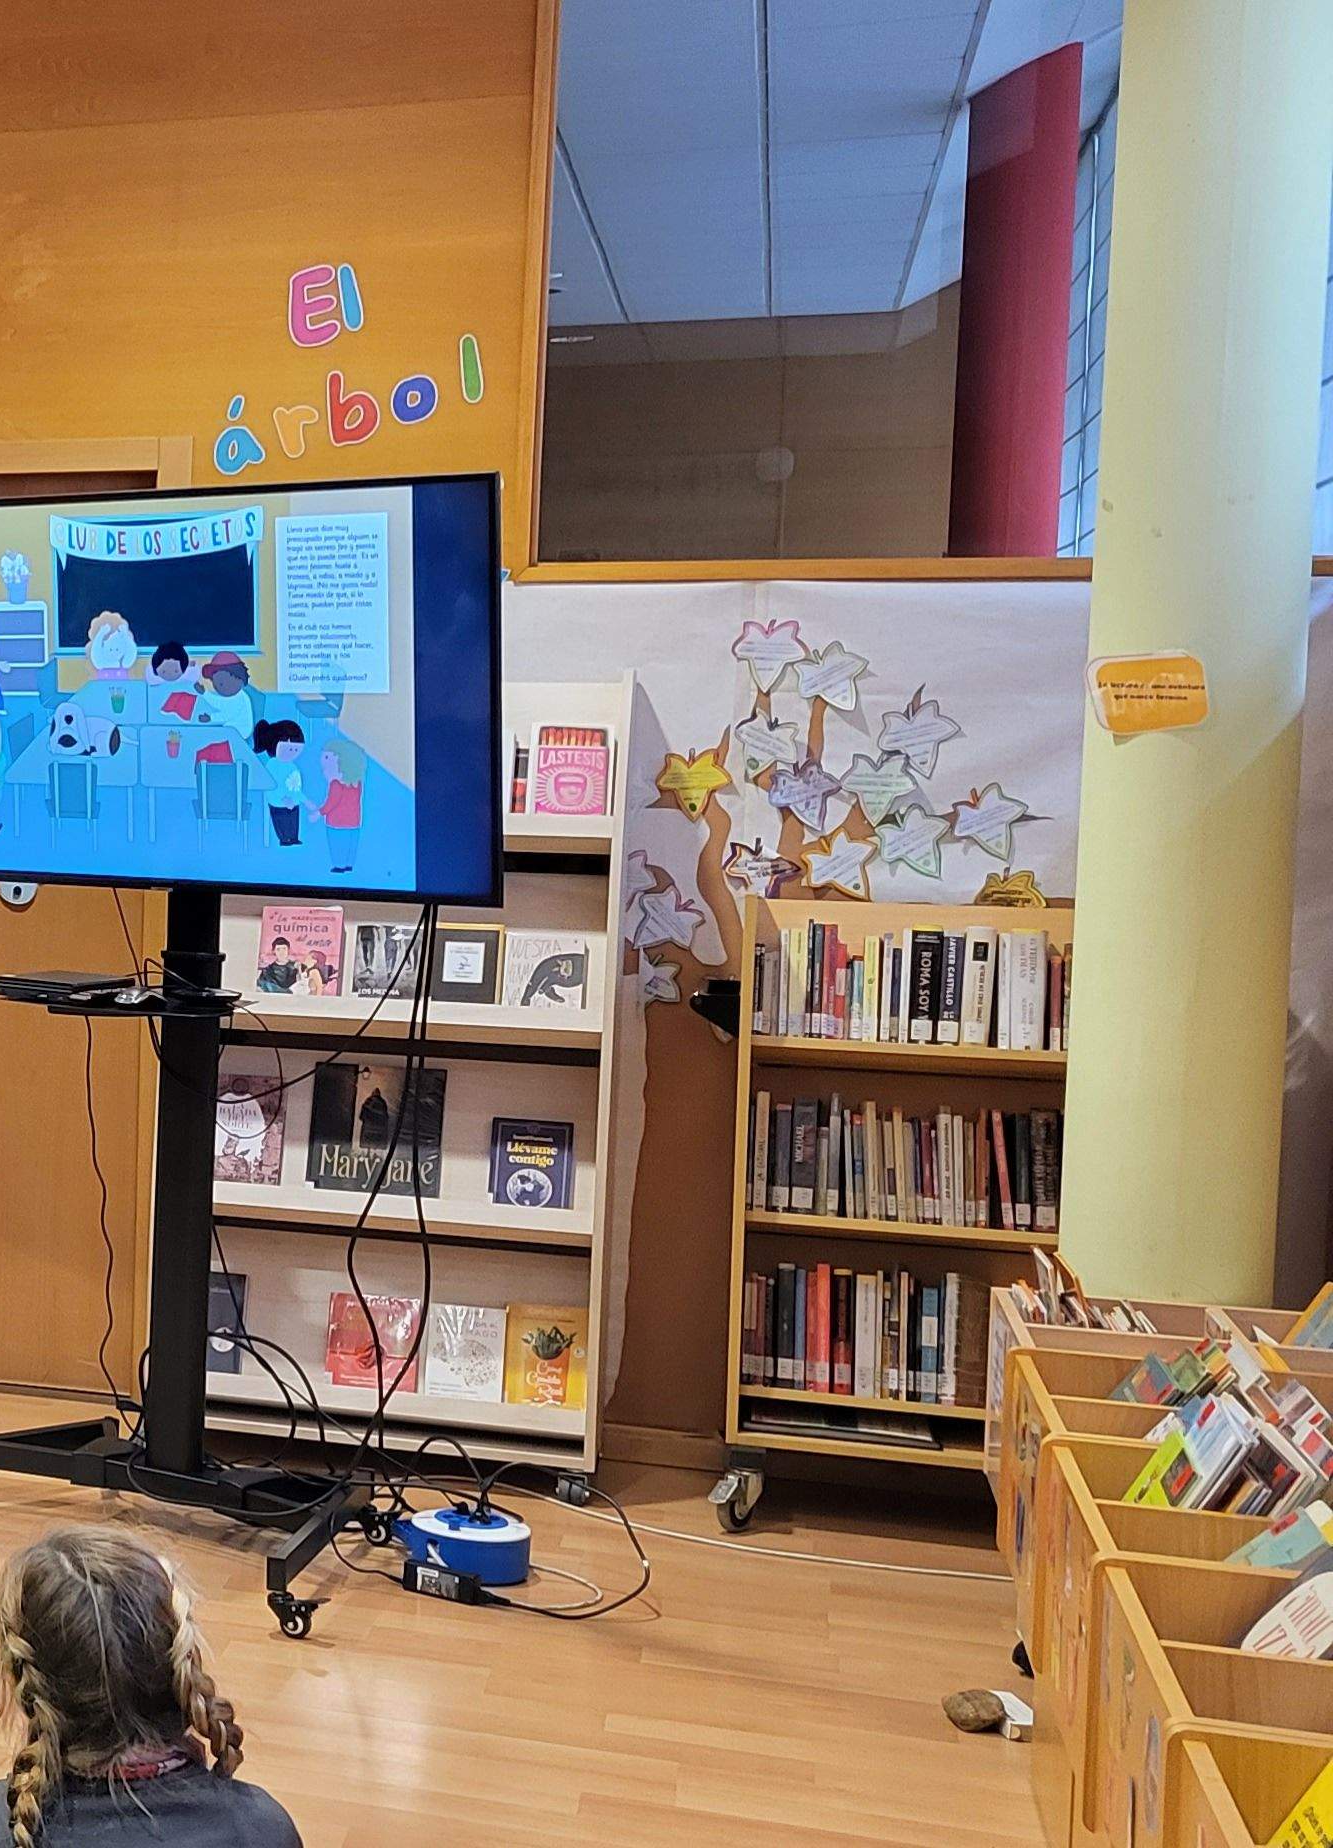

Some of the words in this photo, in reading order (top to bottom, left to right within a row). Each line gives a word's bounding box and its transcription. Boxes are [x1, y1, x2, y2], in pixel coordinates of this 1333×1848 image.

[289, 263, 364, 347] El
[213, 333, 484, 475] árbol
[106, 531, 127, 555] DE
[539, 749, 606, 770] LASTESIS
[273, 921, 329, 934] química
[919, 951, 933, 986] ROMA
[918, 990, 930, 1013] SOY
[506, 1141, 558, 1156] Llévame
[319, 1143, 380, 1189] Mary
[508, 1154, 554, 1168] contigo
